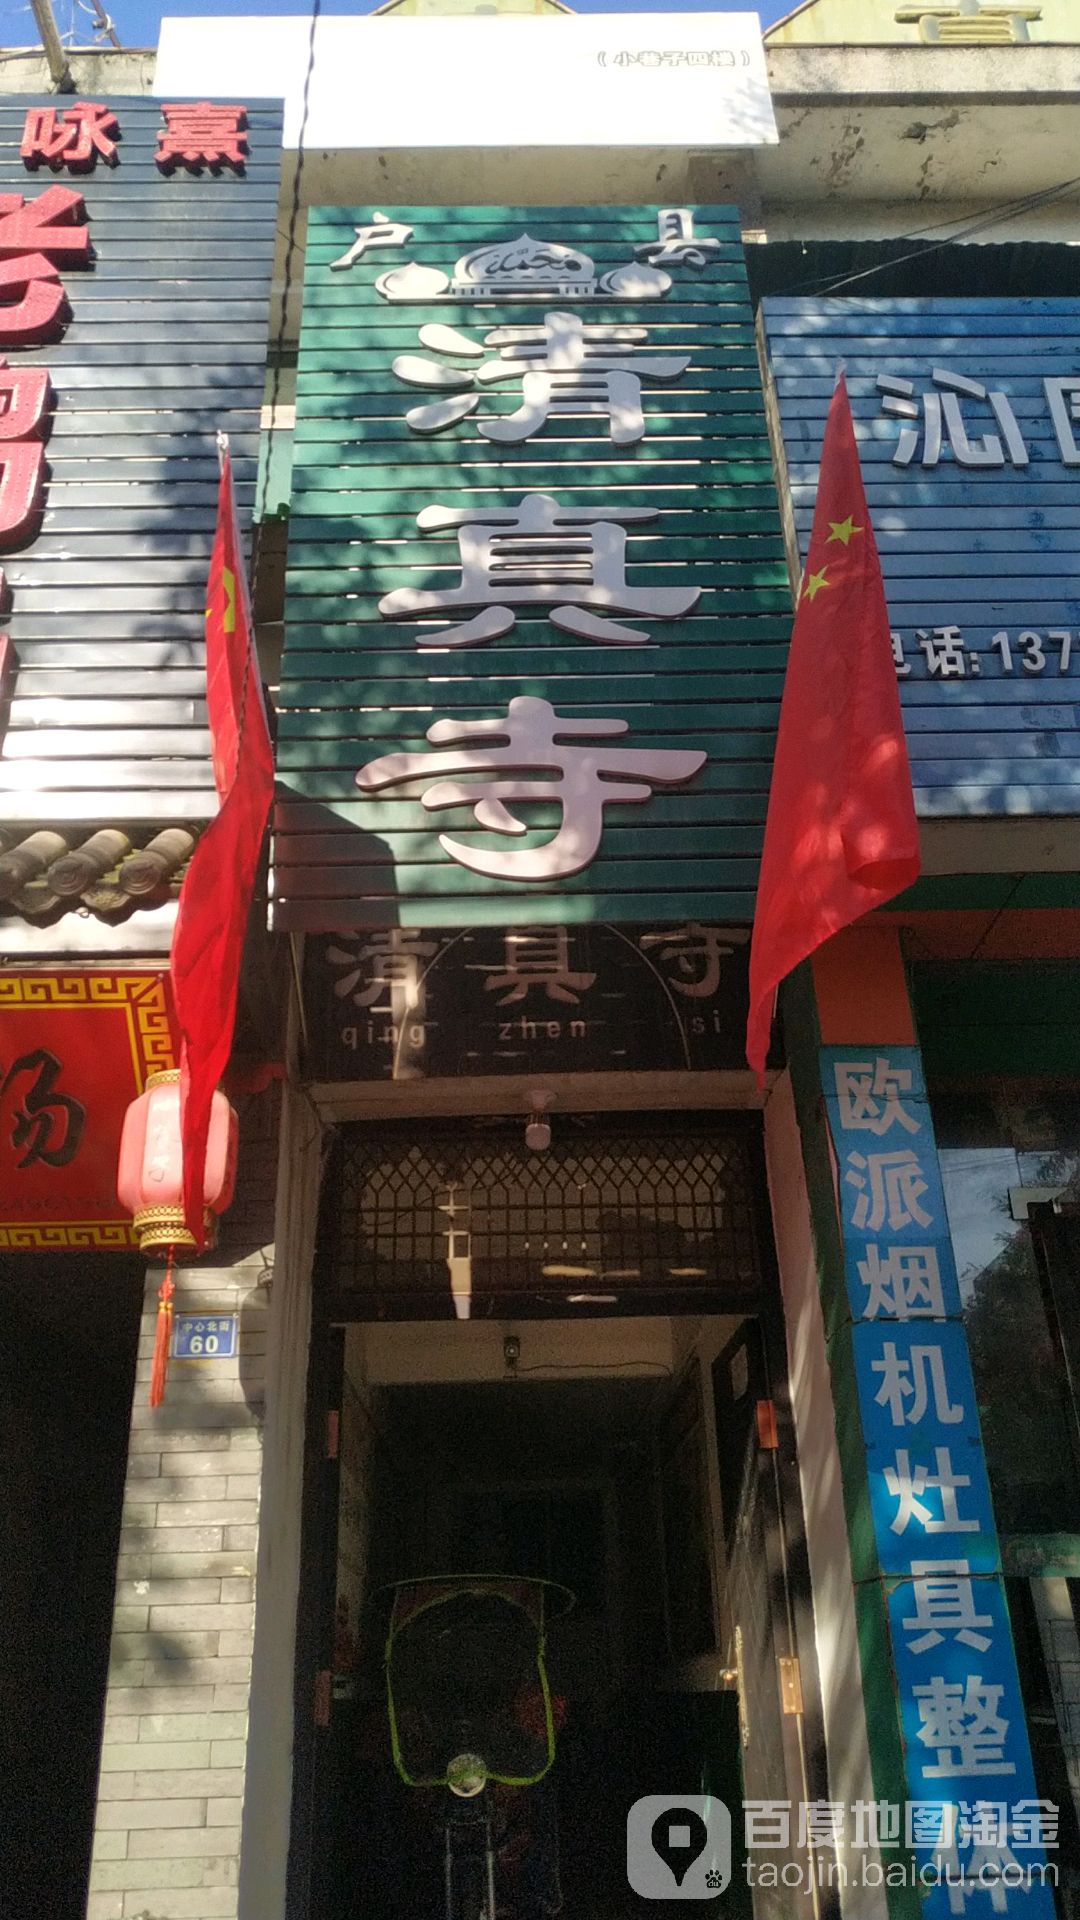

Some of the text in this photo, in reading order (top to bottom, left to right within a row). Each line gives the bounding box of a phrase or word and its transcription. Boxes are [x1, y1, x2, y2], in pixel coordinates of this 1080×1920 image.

[355, 311, 708, 880] 清真寺
[326, 924, 750, 1006] 清真寺
[341, 1010, 722, 1049] qing zhen si
[190, 1335, 219, 1353] 60
